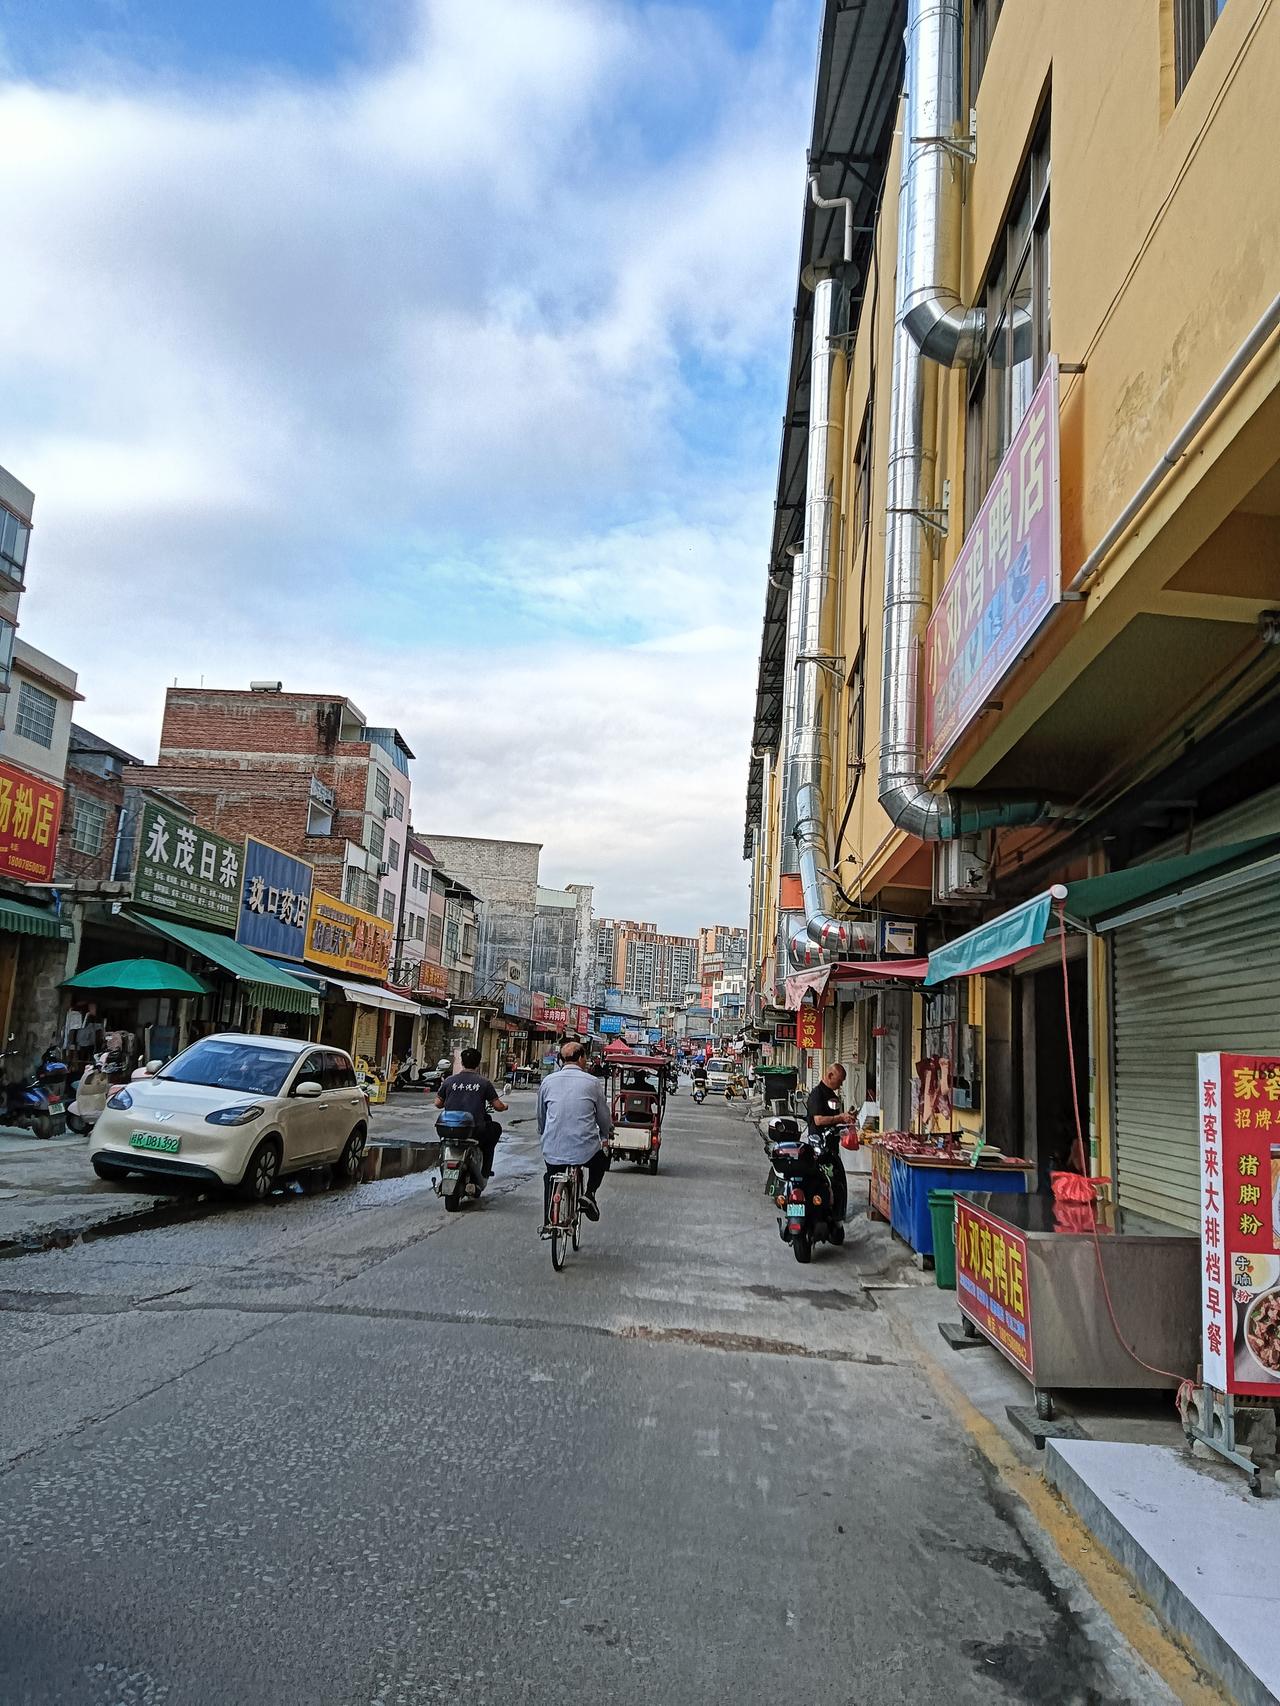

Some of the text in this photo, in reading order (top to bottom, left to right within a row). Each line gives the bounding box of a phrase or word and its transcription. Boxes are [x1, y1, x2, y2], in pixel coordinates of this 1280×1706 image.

[929, 404, 1046, 697] 小邓鸡鸭店
[145, 815, 239, 888] 永茂日杂
[1203, 1079, 1222, 1356] 家客来大排档早餐
[1239, 1153, 1264, 1236] 猪脚粉
[958, 1210, 1025, 1319] 小邓鸡鸭店
